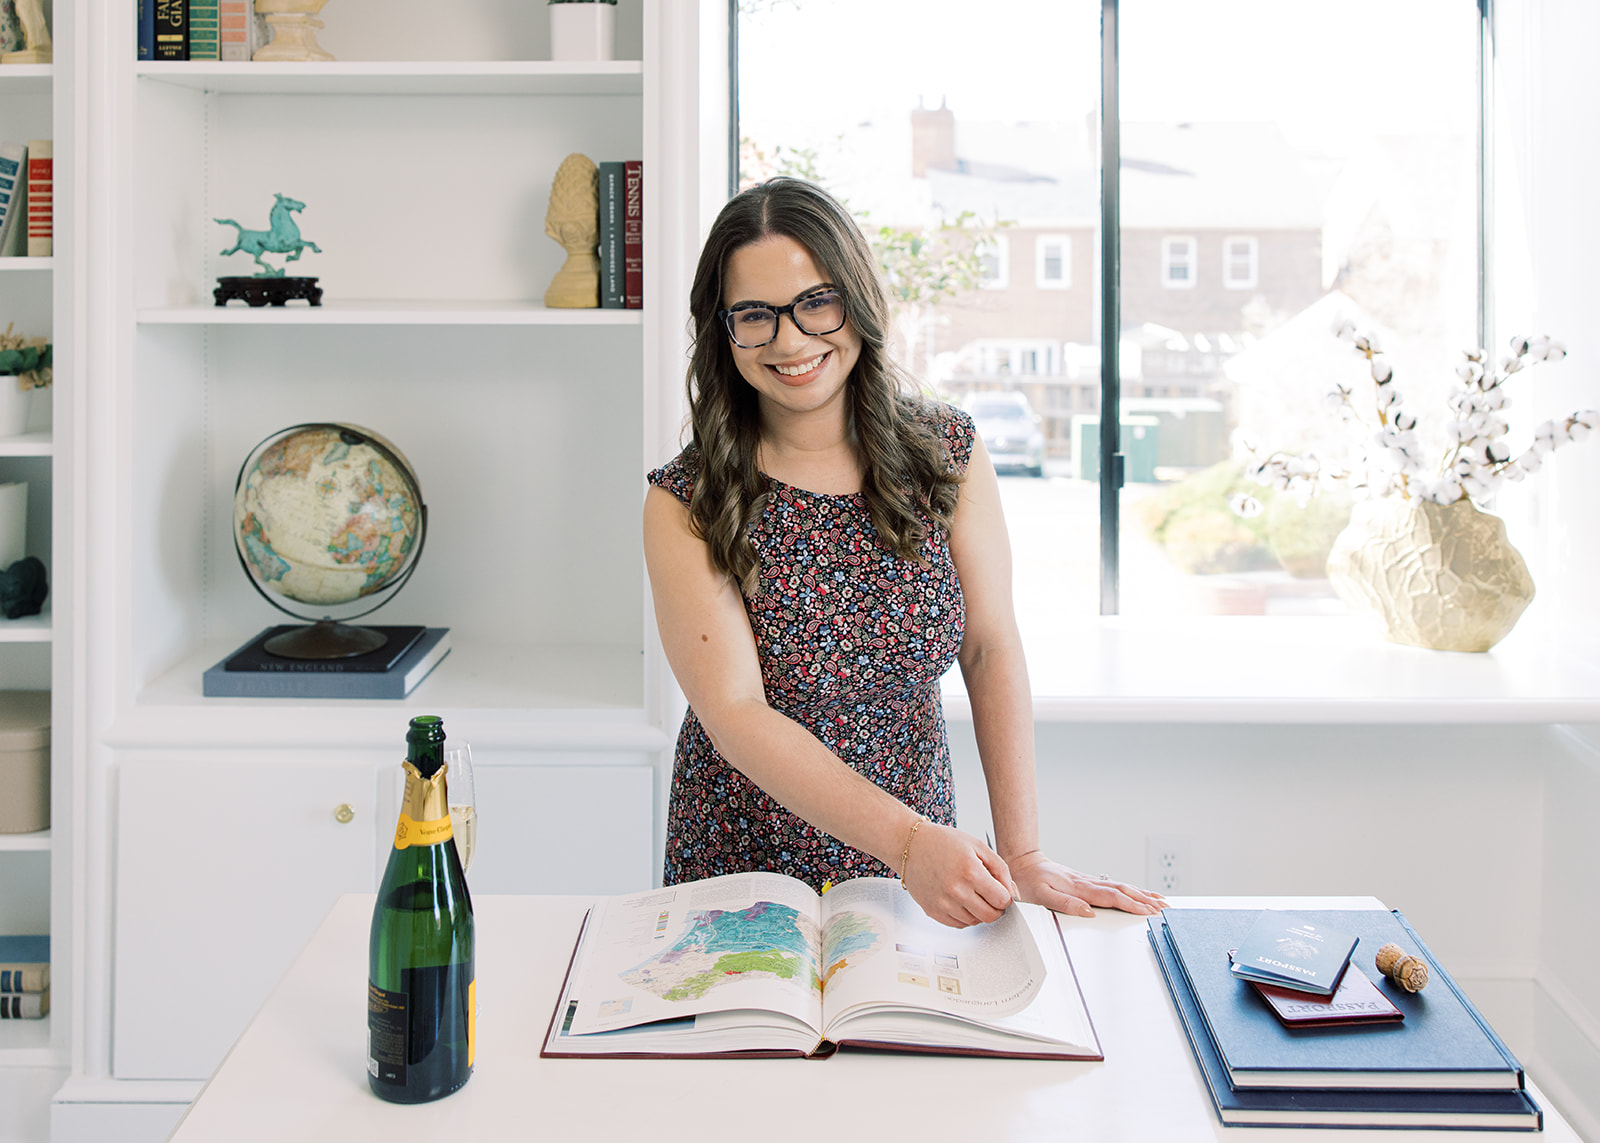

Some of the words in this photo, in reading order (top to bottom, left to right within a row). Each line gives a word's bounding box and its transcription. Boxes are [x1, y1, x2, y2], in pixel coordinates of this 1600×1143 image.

[627, 165, 642, 217] TENNIS
[260, 663, 285, 671] NEW
[289, 663, 344, 672] ENGLAND
[1255, 956, 1317, 977] PASSPORT
[1287, 1001, 1380, 1014] PASSPORT
